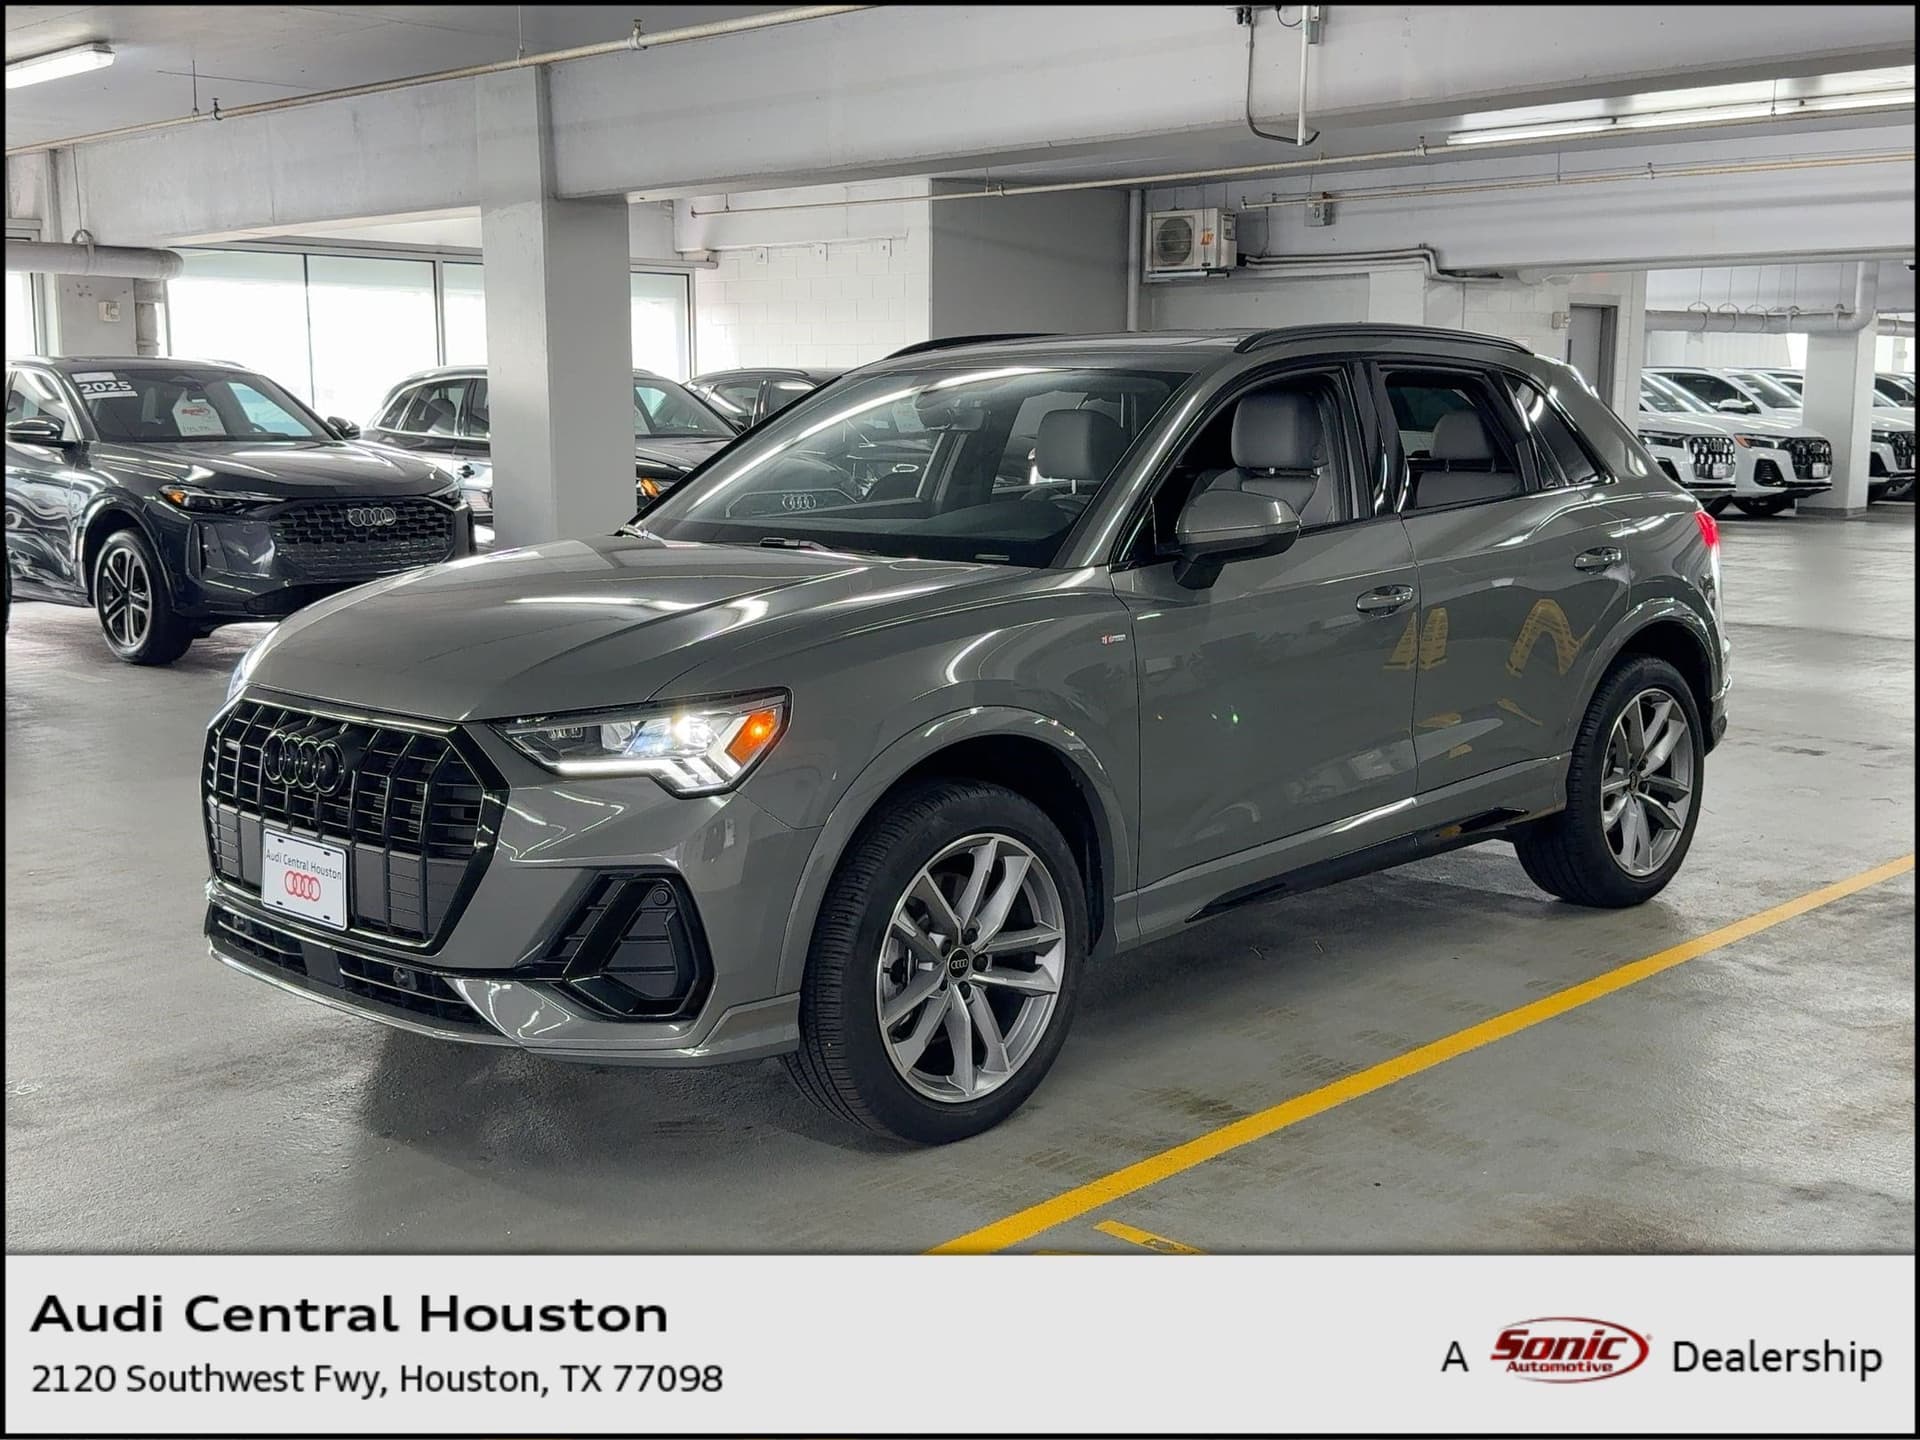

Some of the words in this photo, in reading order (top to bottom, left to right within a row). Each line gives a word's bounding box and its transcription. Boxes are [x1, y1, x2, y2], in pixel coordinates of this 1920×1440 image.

[79, 381, 132, 394] 2025
[266, 850, 282, 864] Audi
[284, 854, 309, 872] Central
[311, 862, 342, 880] Houston
